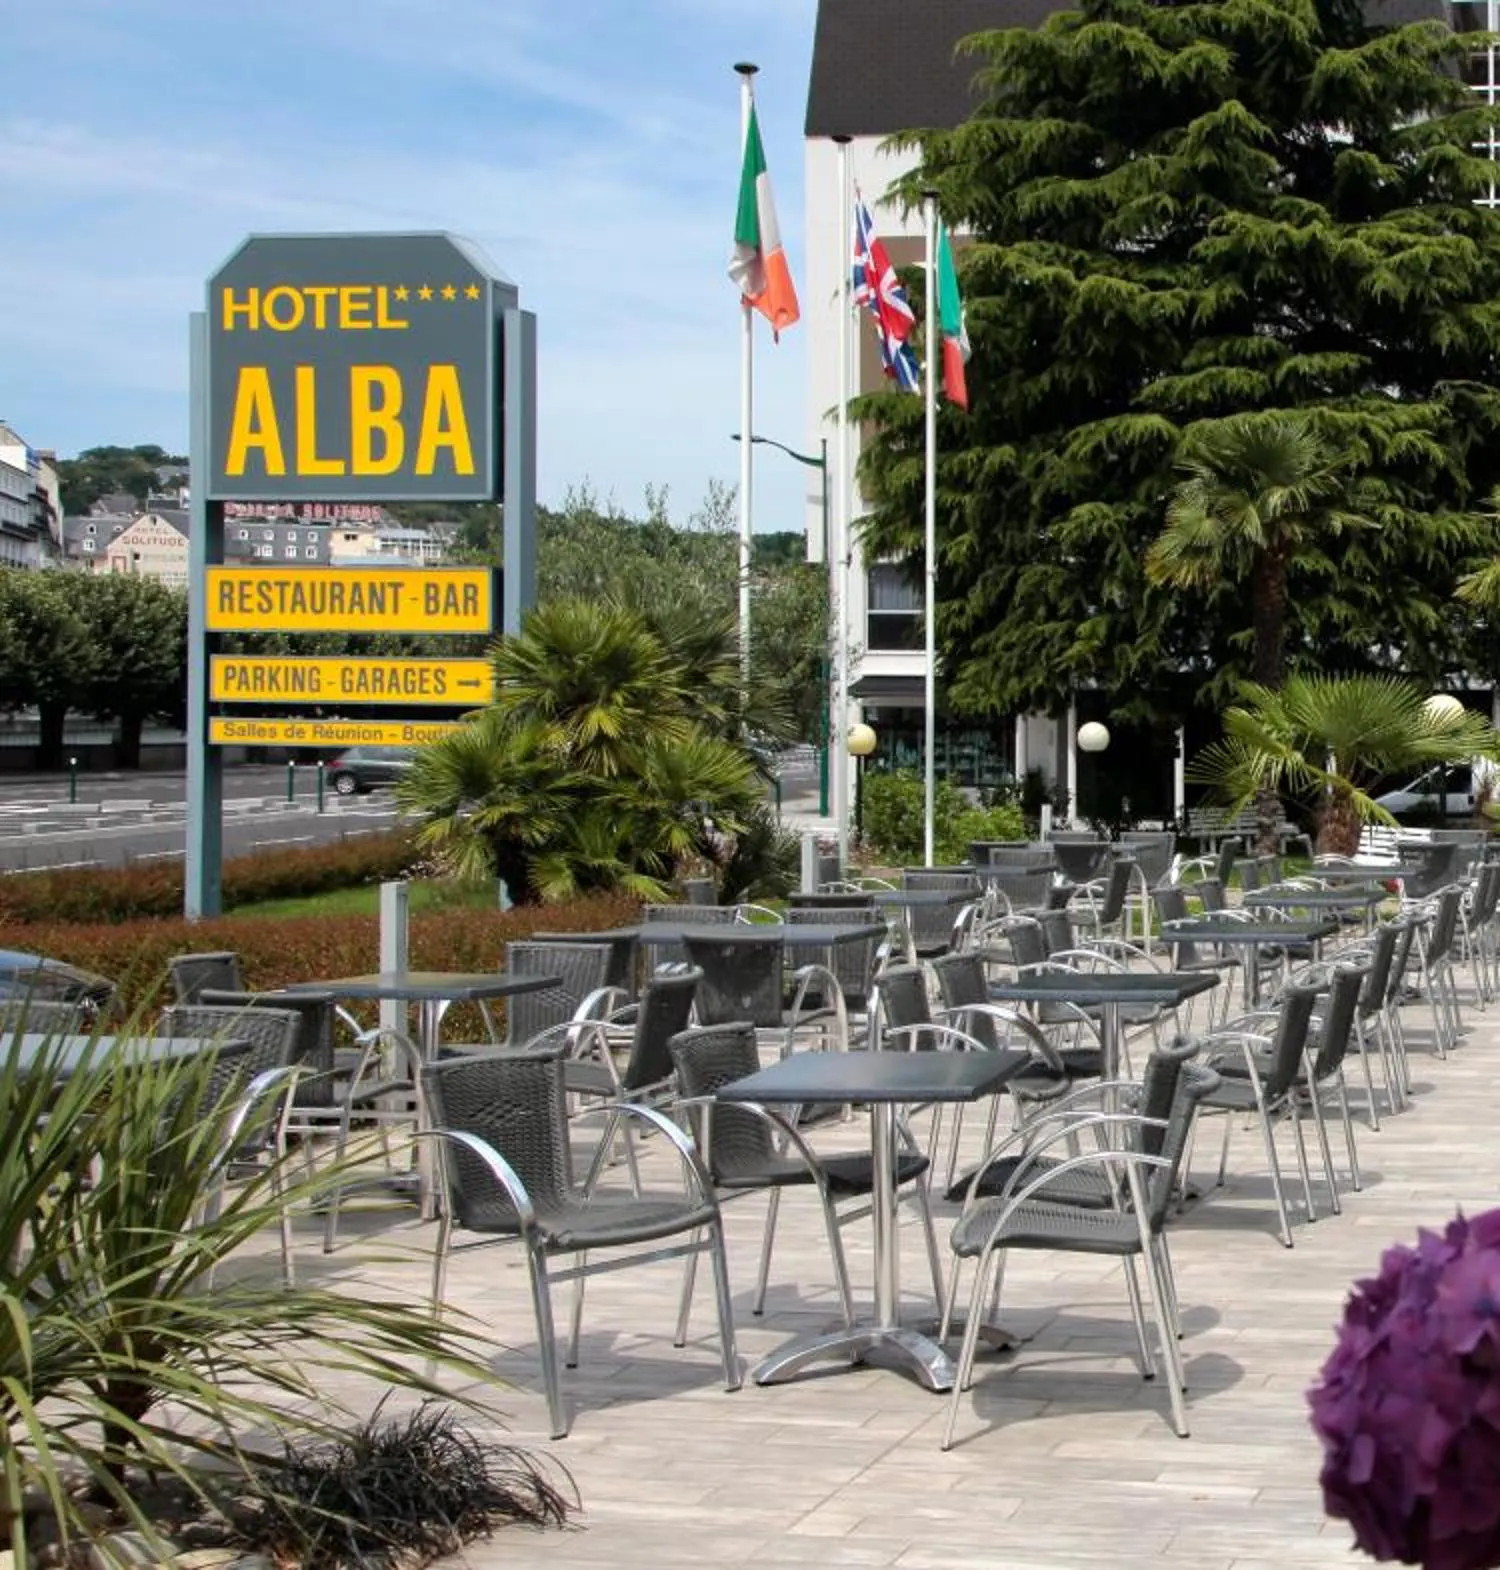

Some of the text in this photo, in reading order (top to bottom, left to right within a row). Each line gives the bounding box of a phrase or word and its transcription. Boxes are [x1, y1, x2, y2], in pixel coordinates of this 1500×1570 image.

[222, 285, 409, 331] HOTEL
[224, 364, 477, 477] ALBA
[122, 535, 185, 547] SOLITUDE
[218, 579, 405, 615] RESTAURANT
[424, 582, 480, 616] BAR
[223, 665, 322, 693] PARKING
[340, 666, 447, 695] GARAGES
[223, 722, 277, 738] Salles
[284, 724, 306, 739] de
[312, 723, 384, 741] Réunion
[402, 726, 459, 744] Bouti
